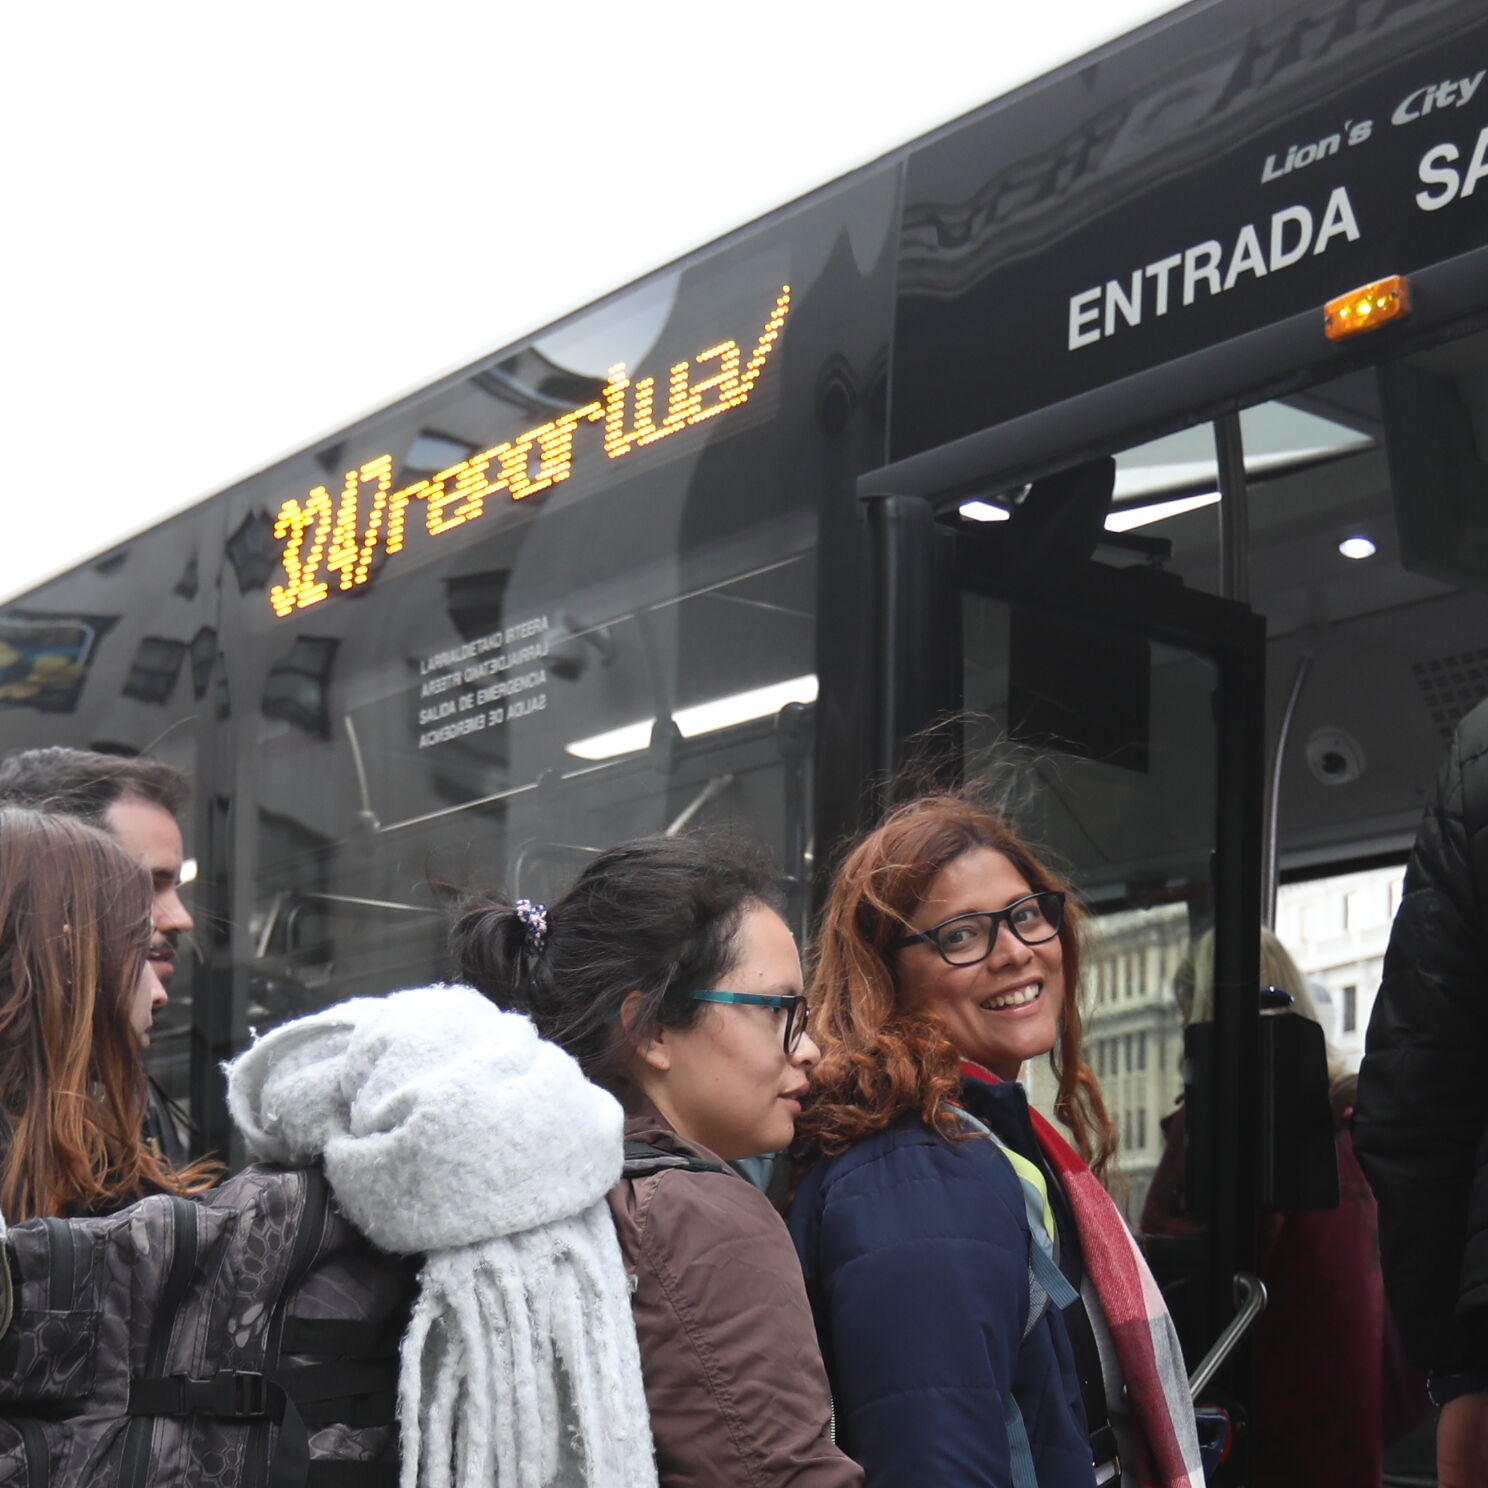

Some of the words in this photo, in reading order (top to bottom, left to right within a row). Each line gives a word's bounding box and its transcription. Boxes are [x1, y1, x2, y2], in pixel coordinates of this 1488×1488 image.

[1261, 119, 1374, 184] Lion's
[1391, 69, 1487, 126] City
[1068, 186, 1360, 351] ENTRADA
[419, 700, 456, 725] SALIDA
[458, 693, 475, 711] DE
[476, 669, 547, 705] EMERGENCIA
